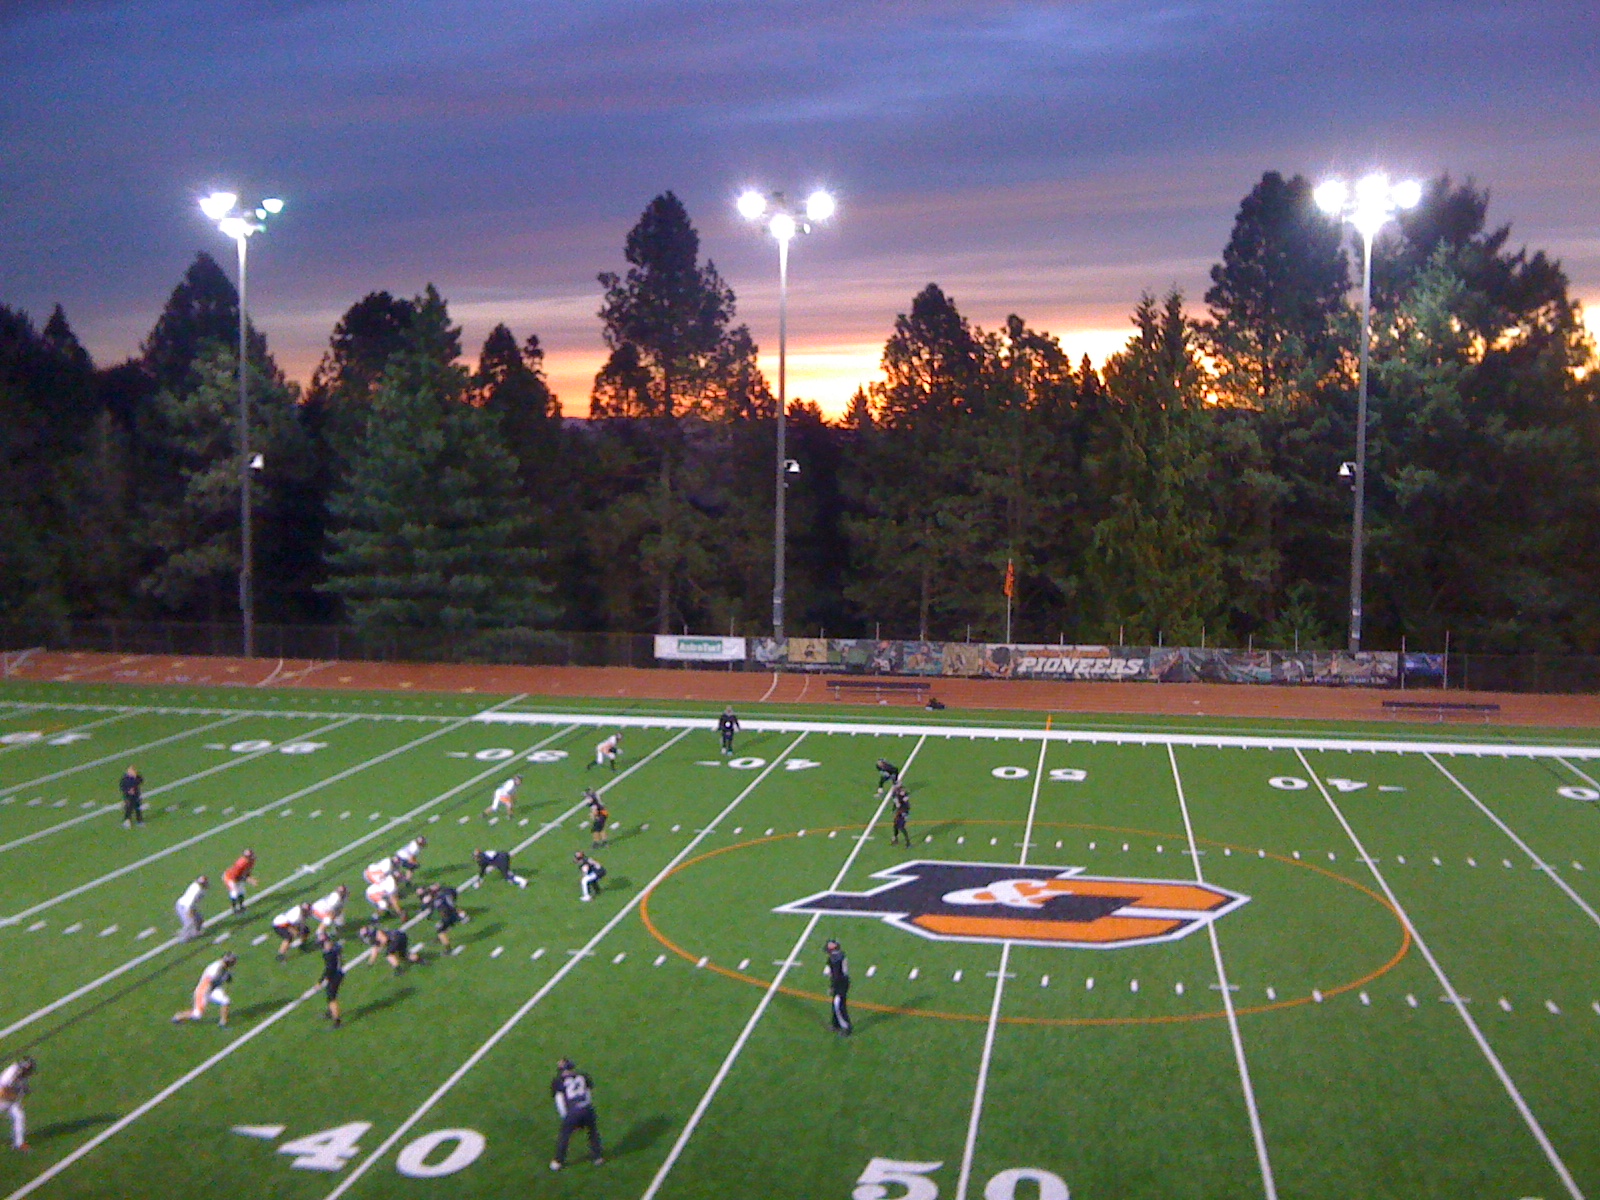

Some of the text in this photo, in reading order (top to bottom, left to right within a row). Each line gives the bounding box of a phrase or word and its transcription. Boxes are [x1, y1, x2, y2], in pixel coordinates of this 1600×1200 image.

[1016, 657, 1144, 676] PIONEERS
[276, 1121, 488, 1179] 40
[851, 1157, 1071, 1200] 50
